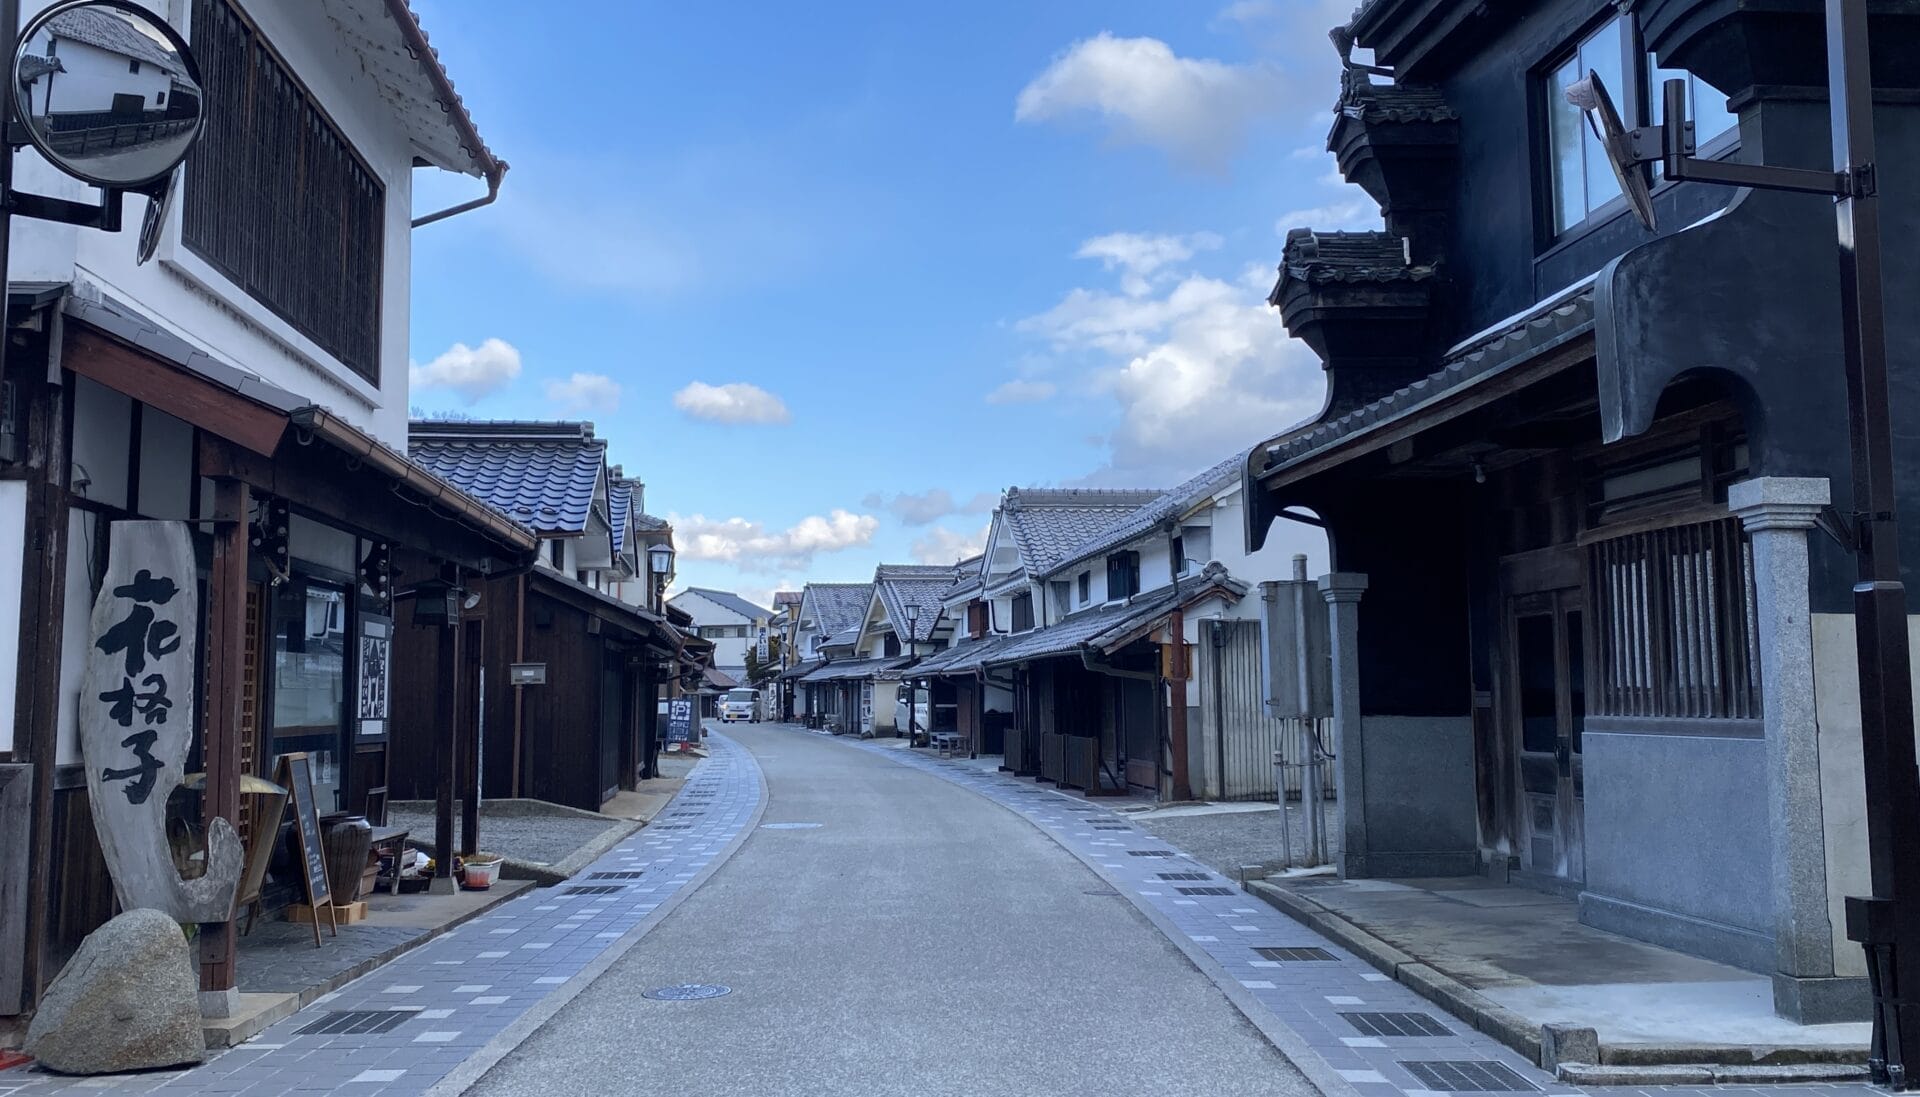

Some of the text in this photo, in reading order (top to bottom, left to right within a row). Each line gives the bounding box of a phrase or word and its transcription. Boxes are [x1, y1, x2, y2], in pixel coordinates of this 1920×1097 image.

[95, 569, 181, 805] 花格子
[675, 705, 686, 715] P
